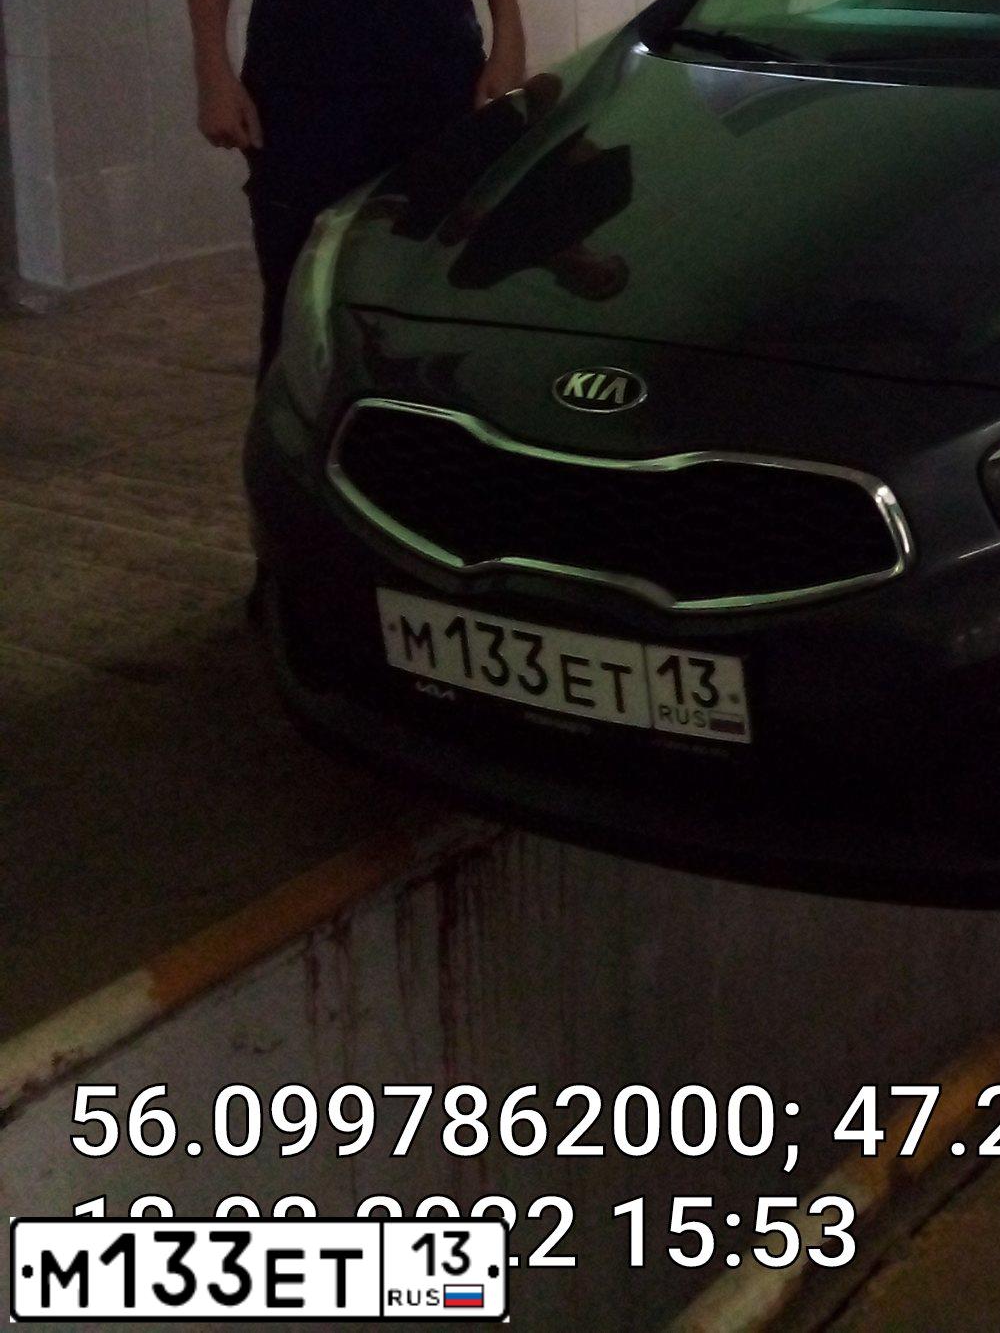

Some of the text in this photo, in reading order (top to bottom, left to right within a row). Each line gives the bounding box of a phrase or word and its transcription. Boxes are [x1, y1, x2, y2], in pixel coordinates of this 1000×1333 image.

[563, 371, 629, 404] KIA
[657, 654, 720, 708] 13
[658, 704, 707, 728] RUS
